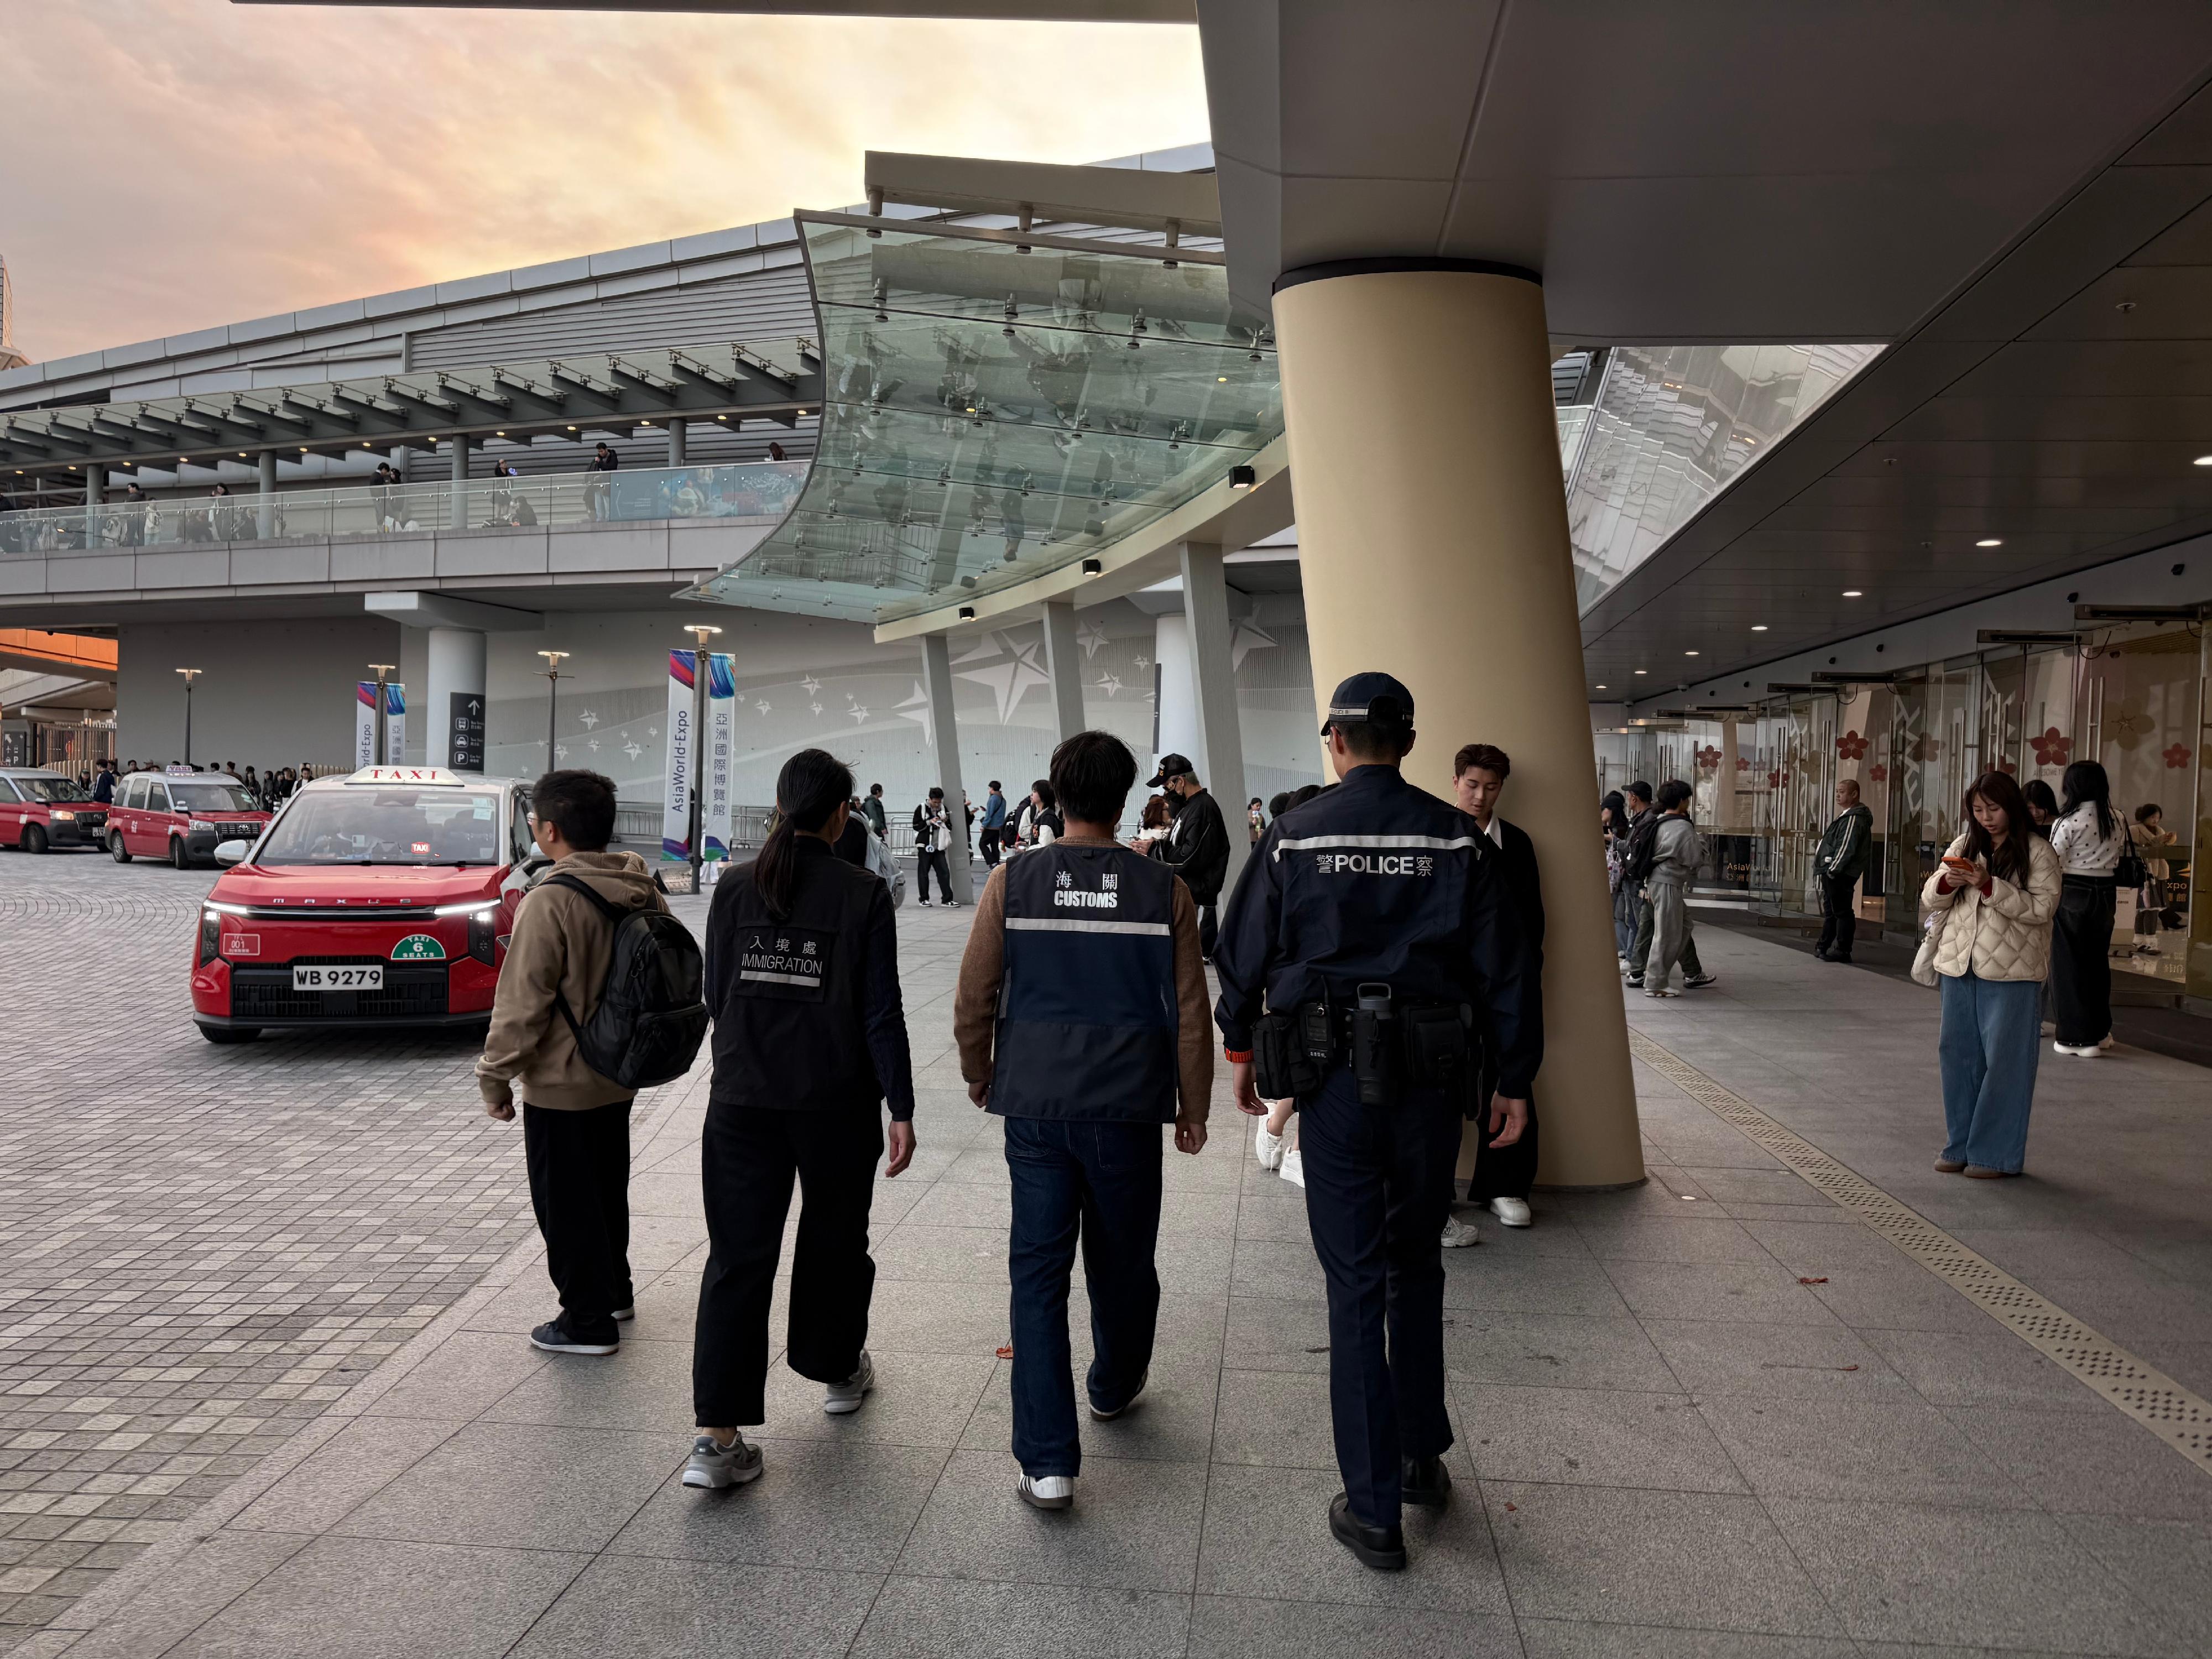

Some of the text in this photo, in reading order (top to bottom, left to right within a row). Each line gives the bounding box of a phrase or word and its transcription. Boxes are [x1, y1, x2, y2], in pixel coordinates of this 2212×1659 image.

[361, 724, 373, 768] orld-Expo
[672, 711, 690, 812] AsiaWorld-Expo
[713, 713, 727, 816] 亞洲國際博覽館
[371, 769, 438, 779] TAXI
[413, 843, 429, 852] TAXI
[1335, 855, 1414, 874] POLICE
[2167, 883, 2187, 891] xpo
[1054, 890, 1118, 908] CUSTOMS
[231, 940, 244, 948] 001
[413, 942, 424, 952] 6
[749, 936, 816, 955] 入境處
[742, 953, 822, 974] IMMIGRATION
[296, 971, 381, 985] WB 9279
